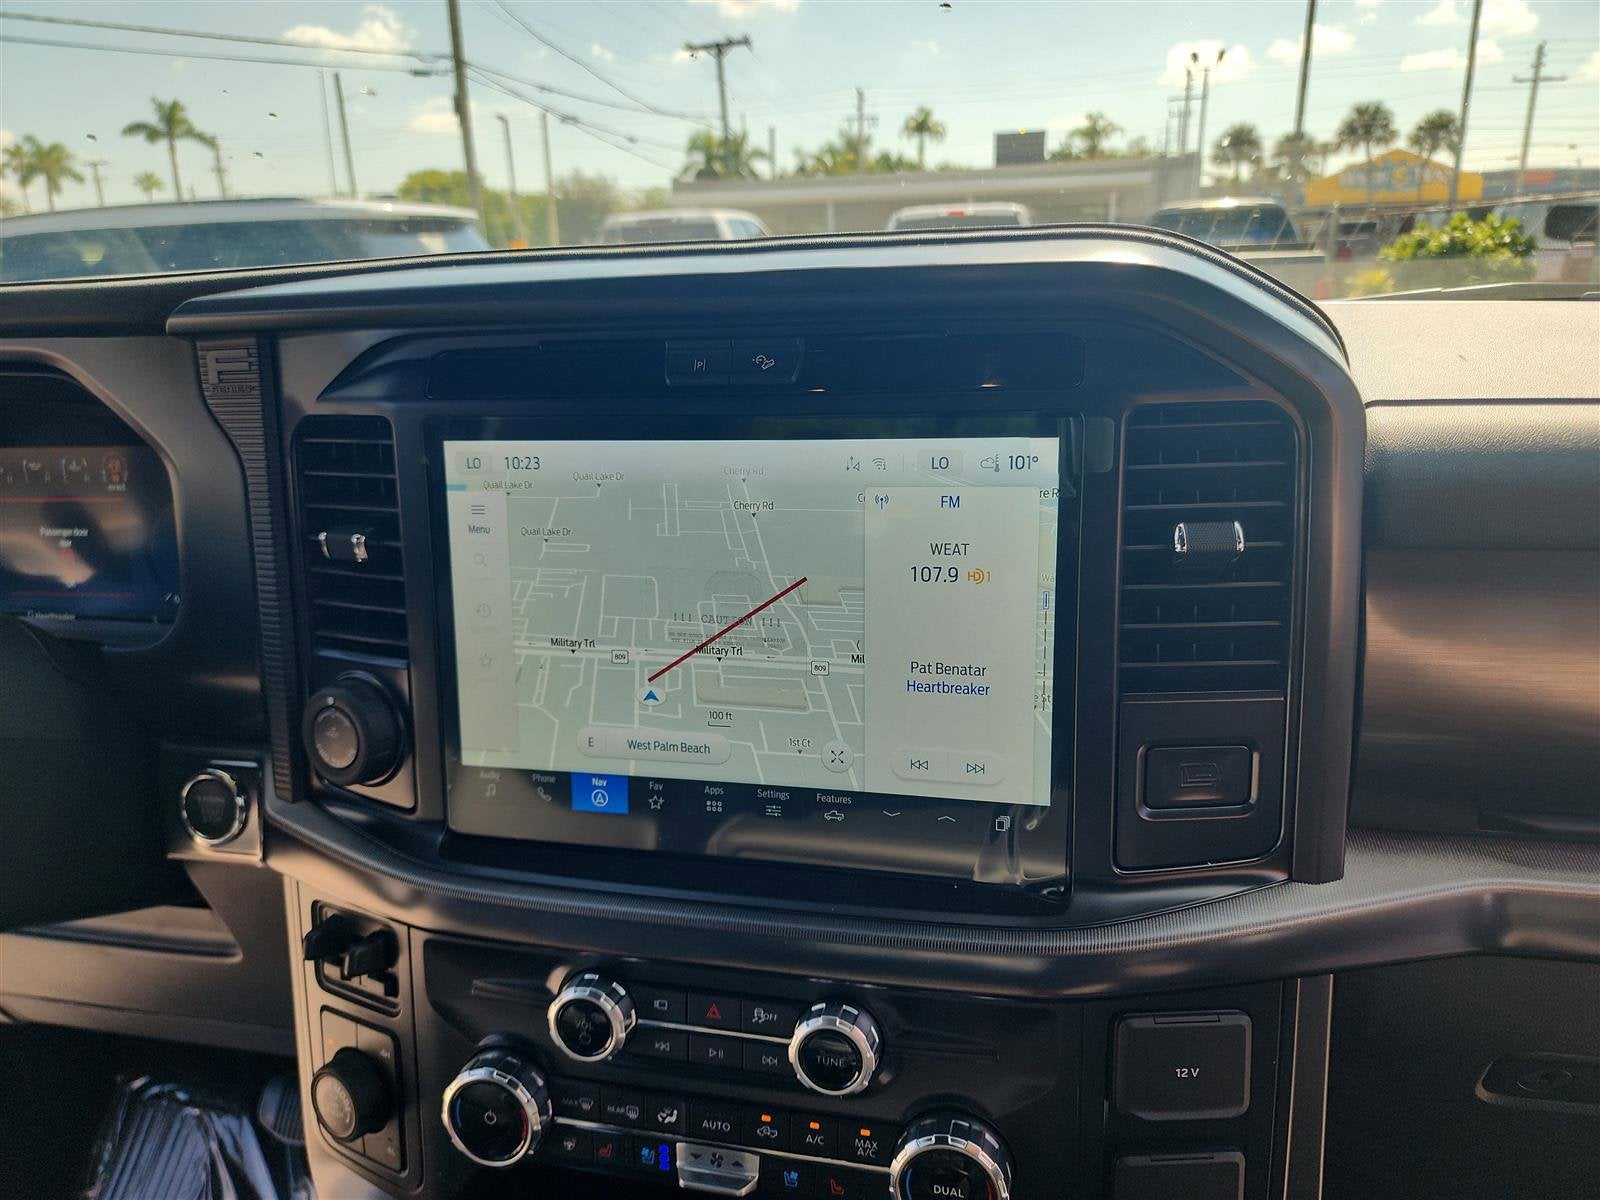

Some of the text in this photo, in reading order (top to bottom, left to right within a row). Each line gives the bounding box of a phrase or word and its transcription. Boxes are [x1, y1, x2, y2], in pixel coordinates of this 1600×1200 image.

[466, 457, 481, 470] LO
[504, 456, 541, 470] 10:23
[930, 456, 949, 470] LO
[1008, 455, 1039, 470] 101°
[573, 471, 625, 482] Quail Lake Dr
[482, 480, 503, 490] Quail
[504, 481, 523, 490] Lake
[733, 500, 774, 512] Cherry Rd
[940, 496, 961, 509] FM
[468, 525, 491, 534] Menu
[520, 527, 542, 539] Quail
[543, 528, 562, 537] Lake
[929, 543, 970, 556] WEAT
[910, 566, 959, 583] 107.9
[551, 637, 595, 649] Military Trl
[614, 653, 626, 661] 809
[696, 645, 743, 657] Military Trl
[813, 664, 827, 673] 809
[910, 661, 987, 677] Pat Benatar
[906, 680, 991, 696] Heartbreaker
[708, 711, 733, 721] 100 ft
[588, 738, 595, 748] E
[627, 739, 711, 754] West Palm Beach
[789, 738, 811, 748] 1st Ct
[532, 774, 557, 784] Phone
[592, 777, 608, 788] Nav
[649, 781, 664, 791] Fav
[704, 785, 724, 797] Apps
[757, 789, 790, 800] Settings
[816, 793, 852, 804] Features
[763, 1012, 778, 1022] OFF
[816, 1056, 846, 1068] TUNE
[1175, 1068, 1200, 1078] 12 V
[702, 1119, 731, 1132] AUTO
[805, 1133, 825, 1146] A/C
[854, 1138, 878, 1150] MAX
[856, 1147, 877, 1159] A/C
[933, 1184, 965, 1199] DUAL
